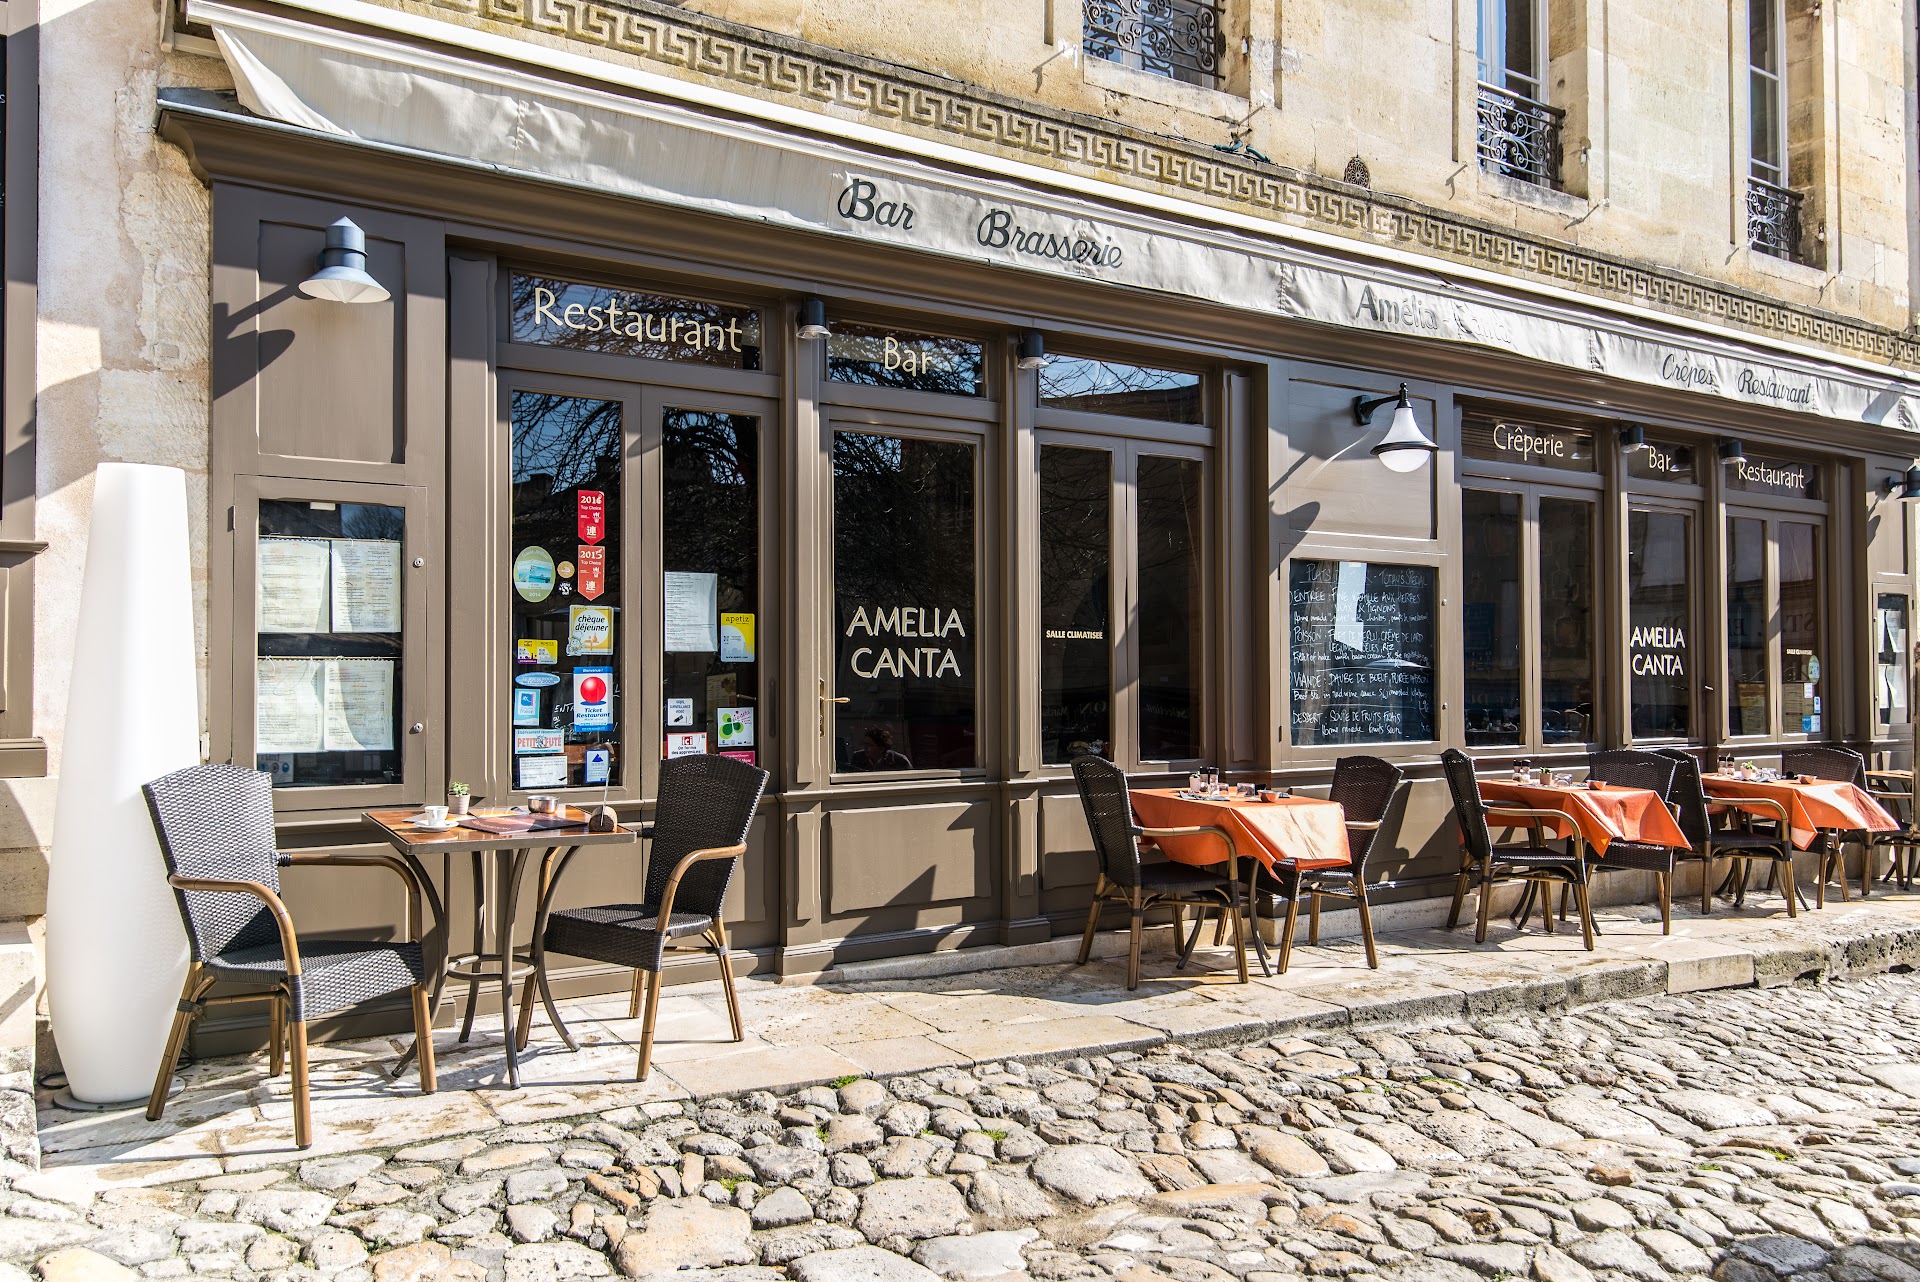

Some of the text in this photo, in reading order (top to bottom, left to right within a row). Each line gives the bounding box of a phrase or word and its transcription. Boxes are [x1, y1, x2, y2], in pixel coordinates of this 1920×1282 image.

[838, 178, 1122, 269] Bar Brasserie
[534, 287, 743, 353] Restaurant
[1355, 283, 1438, 330] Amélia
[885, 336, 934, 378] Bar
[1662, 353, 1812, 404] Crêpes Restaurant
[1493, 424, 1565, 462] Crêperie
[1649, 445, 1672, 473] Bar
[1738, 460, 1805, 490] Restaurant
[580, 495, 602, 504] 2016
[579, 550, 603, 560] 2015
[575, 623, 609, 633] déjeuner
[577, 615, 606, 624] chèque
[725, 614, 750, 624] apetiz
[846, 604, 966, 639] AMELIA
[1046, 630, 1066, 639] SALLE
[1630, 625, 1686, 648] AMELIA
[849, 646, 962, 680] CANTA
[1632, 653, 1684, 676] CANTA
[517, 735, 562, 748] PETIT FUTÉ
